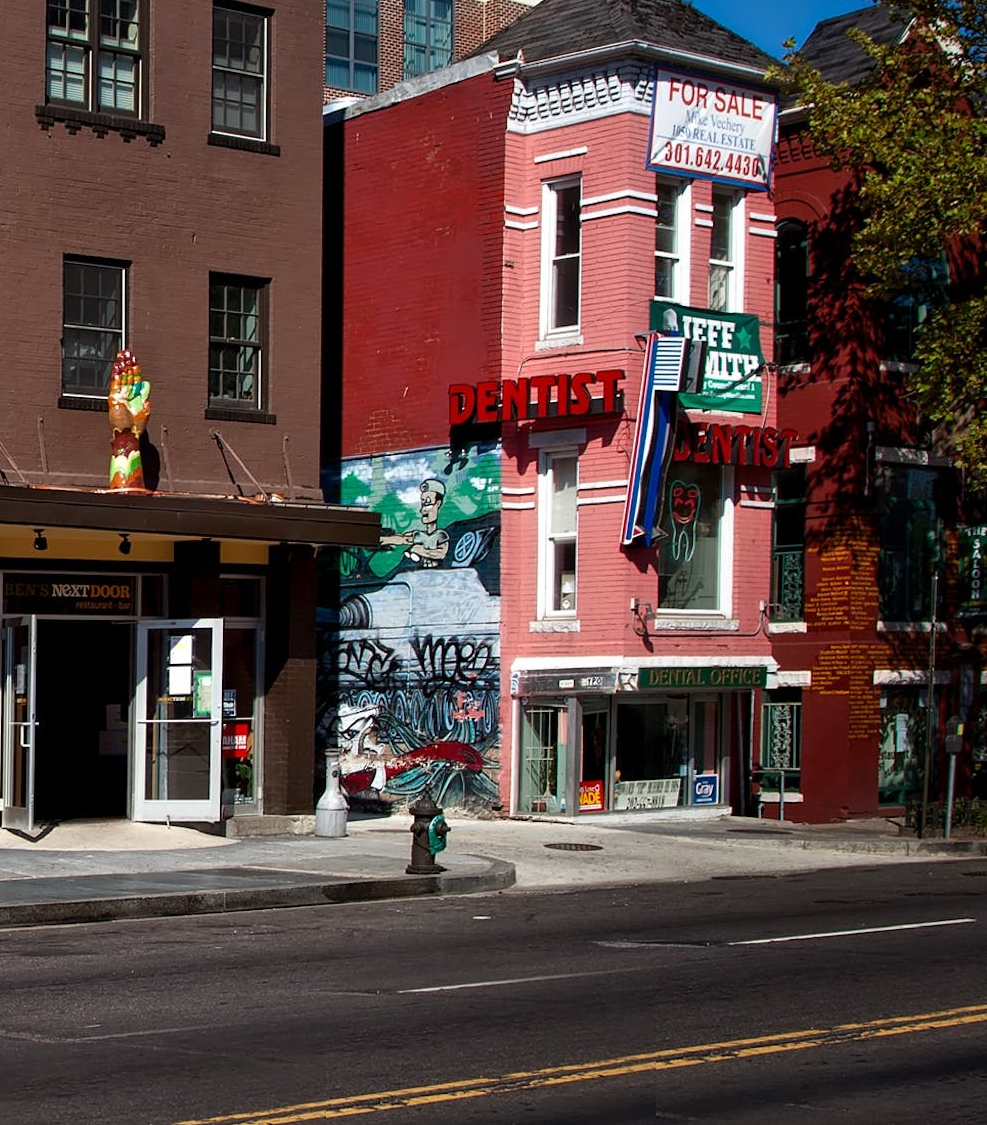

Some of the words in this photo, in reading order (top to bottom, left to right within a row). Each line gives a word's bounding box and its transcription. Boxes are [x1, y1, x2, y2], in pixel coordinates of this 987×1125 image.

[668, 76, 709, 109] FOR
[714, 86, 764, 121] SALE
[693, 128, 720, 146] REAL
[721, 135, 756, 151] ESTATE
[665, 141, 760, 178] 301.642.4430
[705, 350, 760, 378] MITH
[448, 369, 625, 425] DENTIST
[674, 422, 799, 469] DENTIST
[965, 526, 987, 536] THE
[971, 539, 982, 599] SALOON
[90, 584, 131, 599] DOOR
[648, 669, 705, 685] DENTAL
[709, 666, 762, 685] OFFICE
